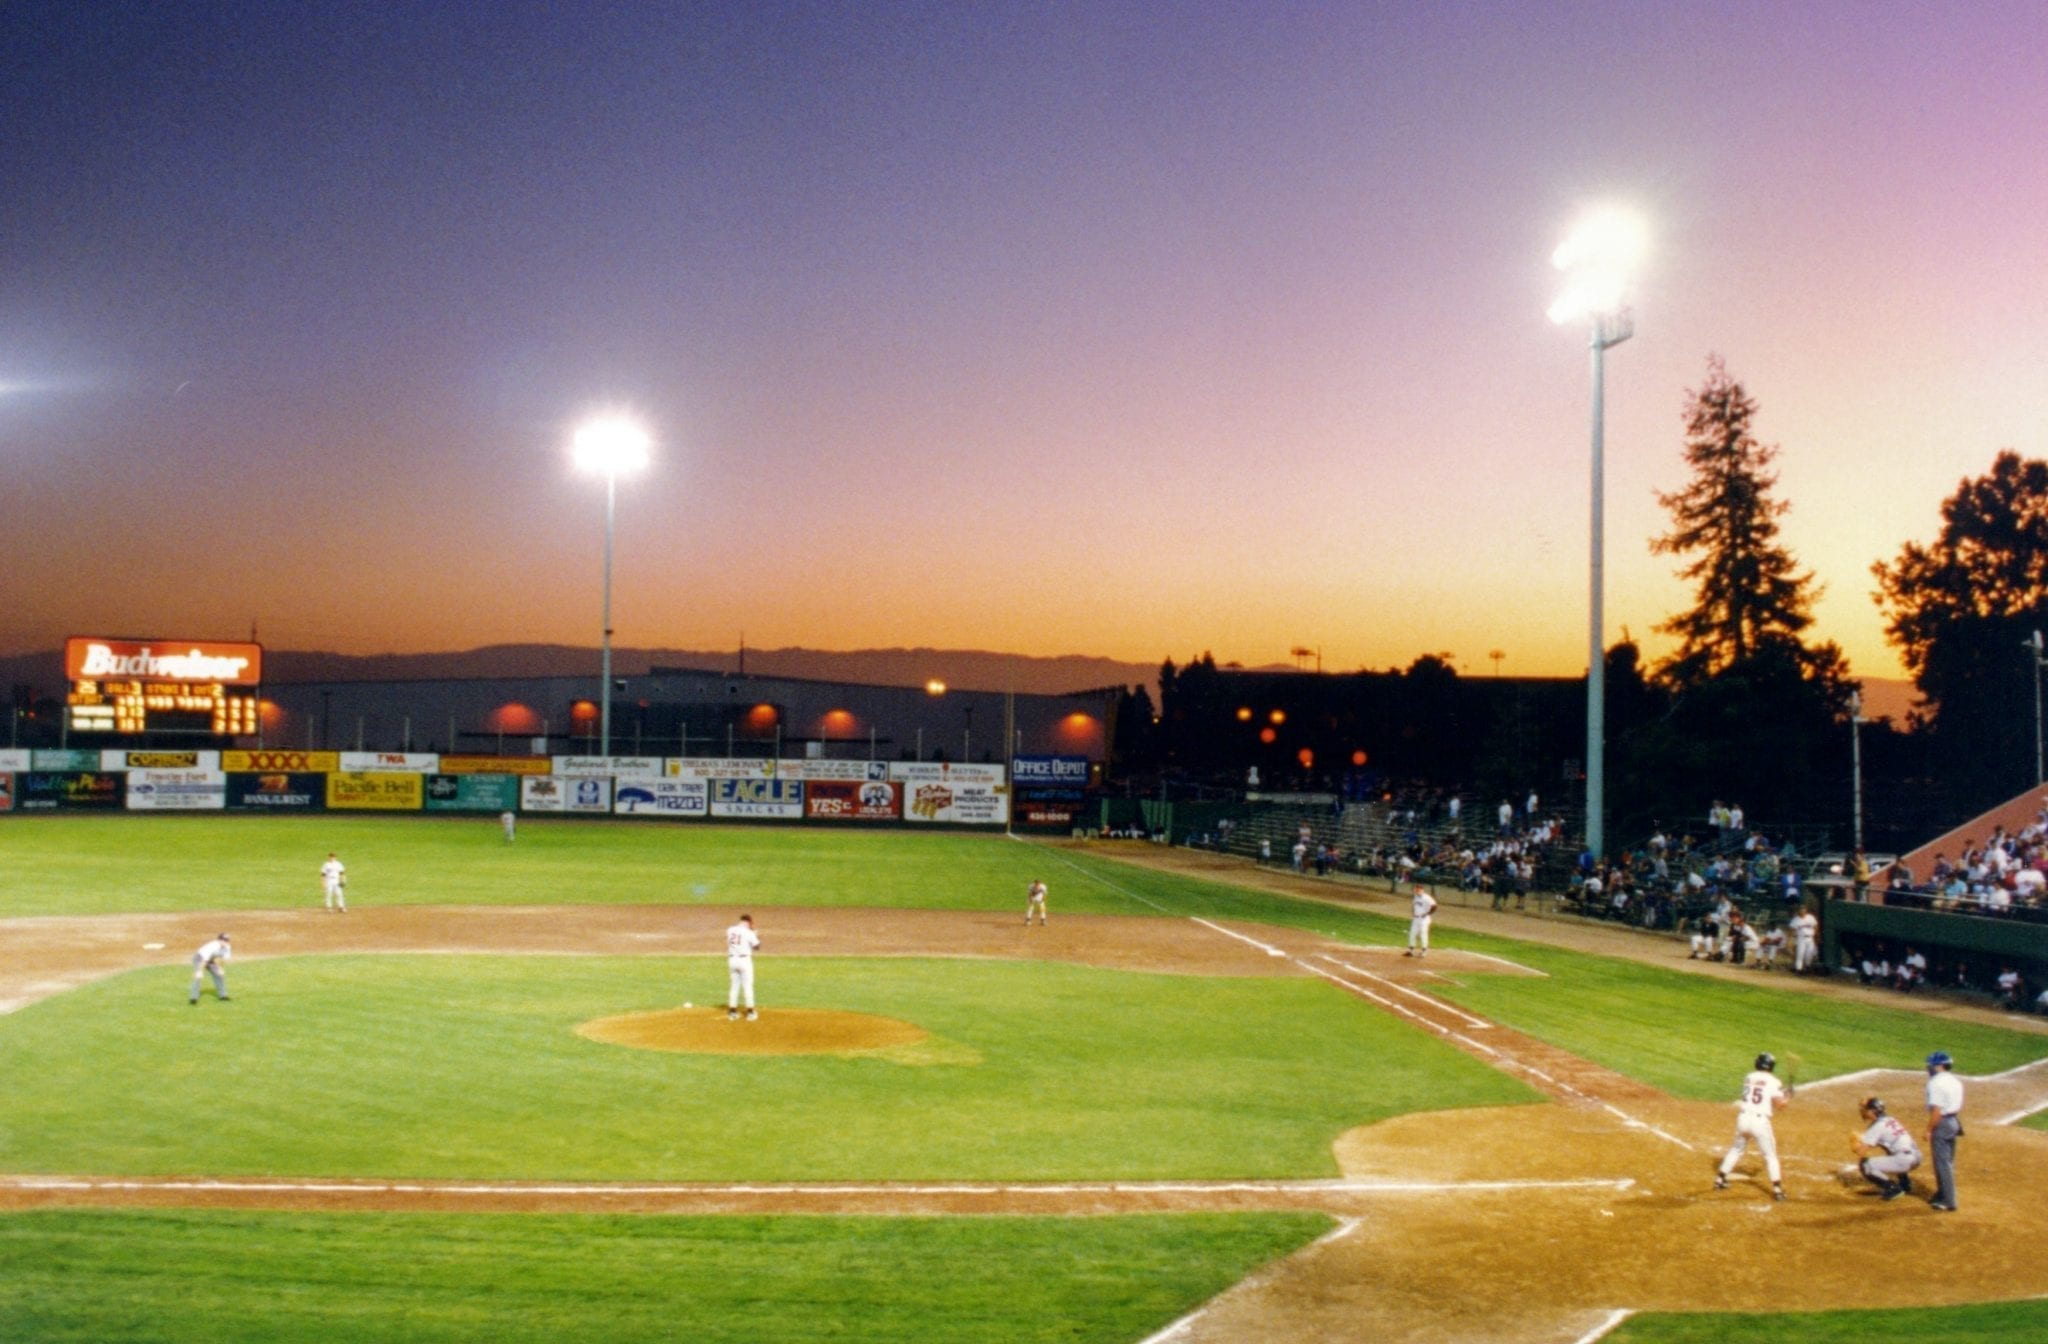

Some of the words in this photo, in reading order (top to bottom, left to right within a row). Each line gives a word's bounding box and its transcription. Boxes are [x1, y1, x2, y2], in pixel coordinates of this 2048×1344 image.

[377, 754, 406, 764] TWA
[1013, 759, 1051, 774] OFFICE
[1052, 759, 1087, 774] DEPOT
[384, 780, 416, 794] Bell
[714, 780, 802, 803] EAGLE
[657, 795, 704, 809] mazda
[810, 798, 843, 813] YES
